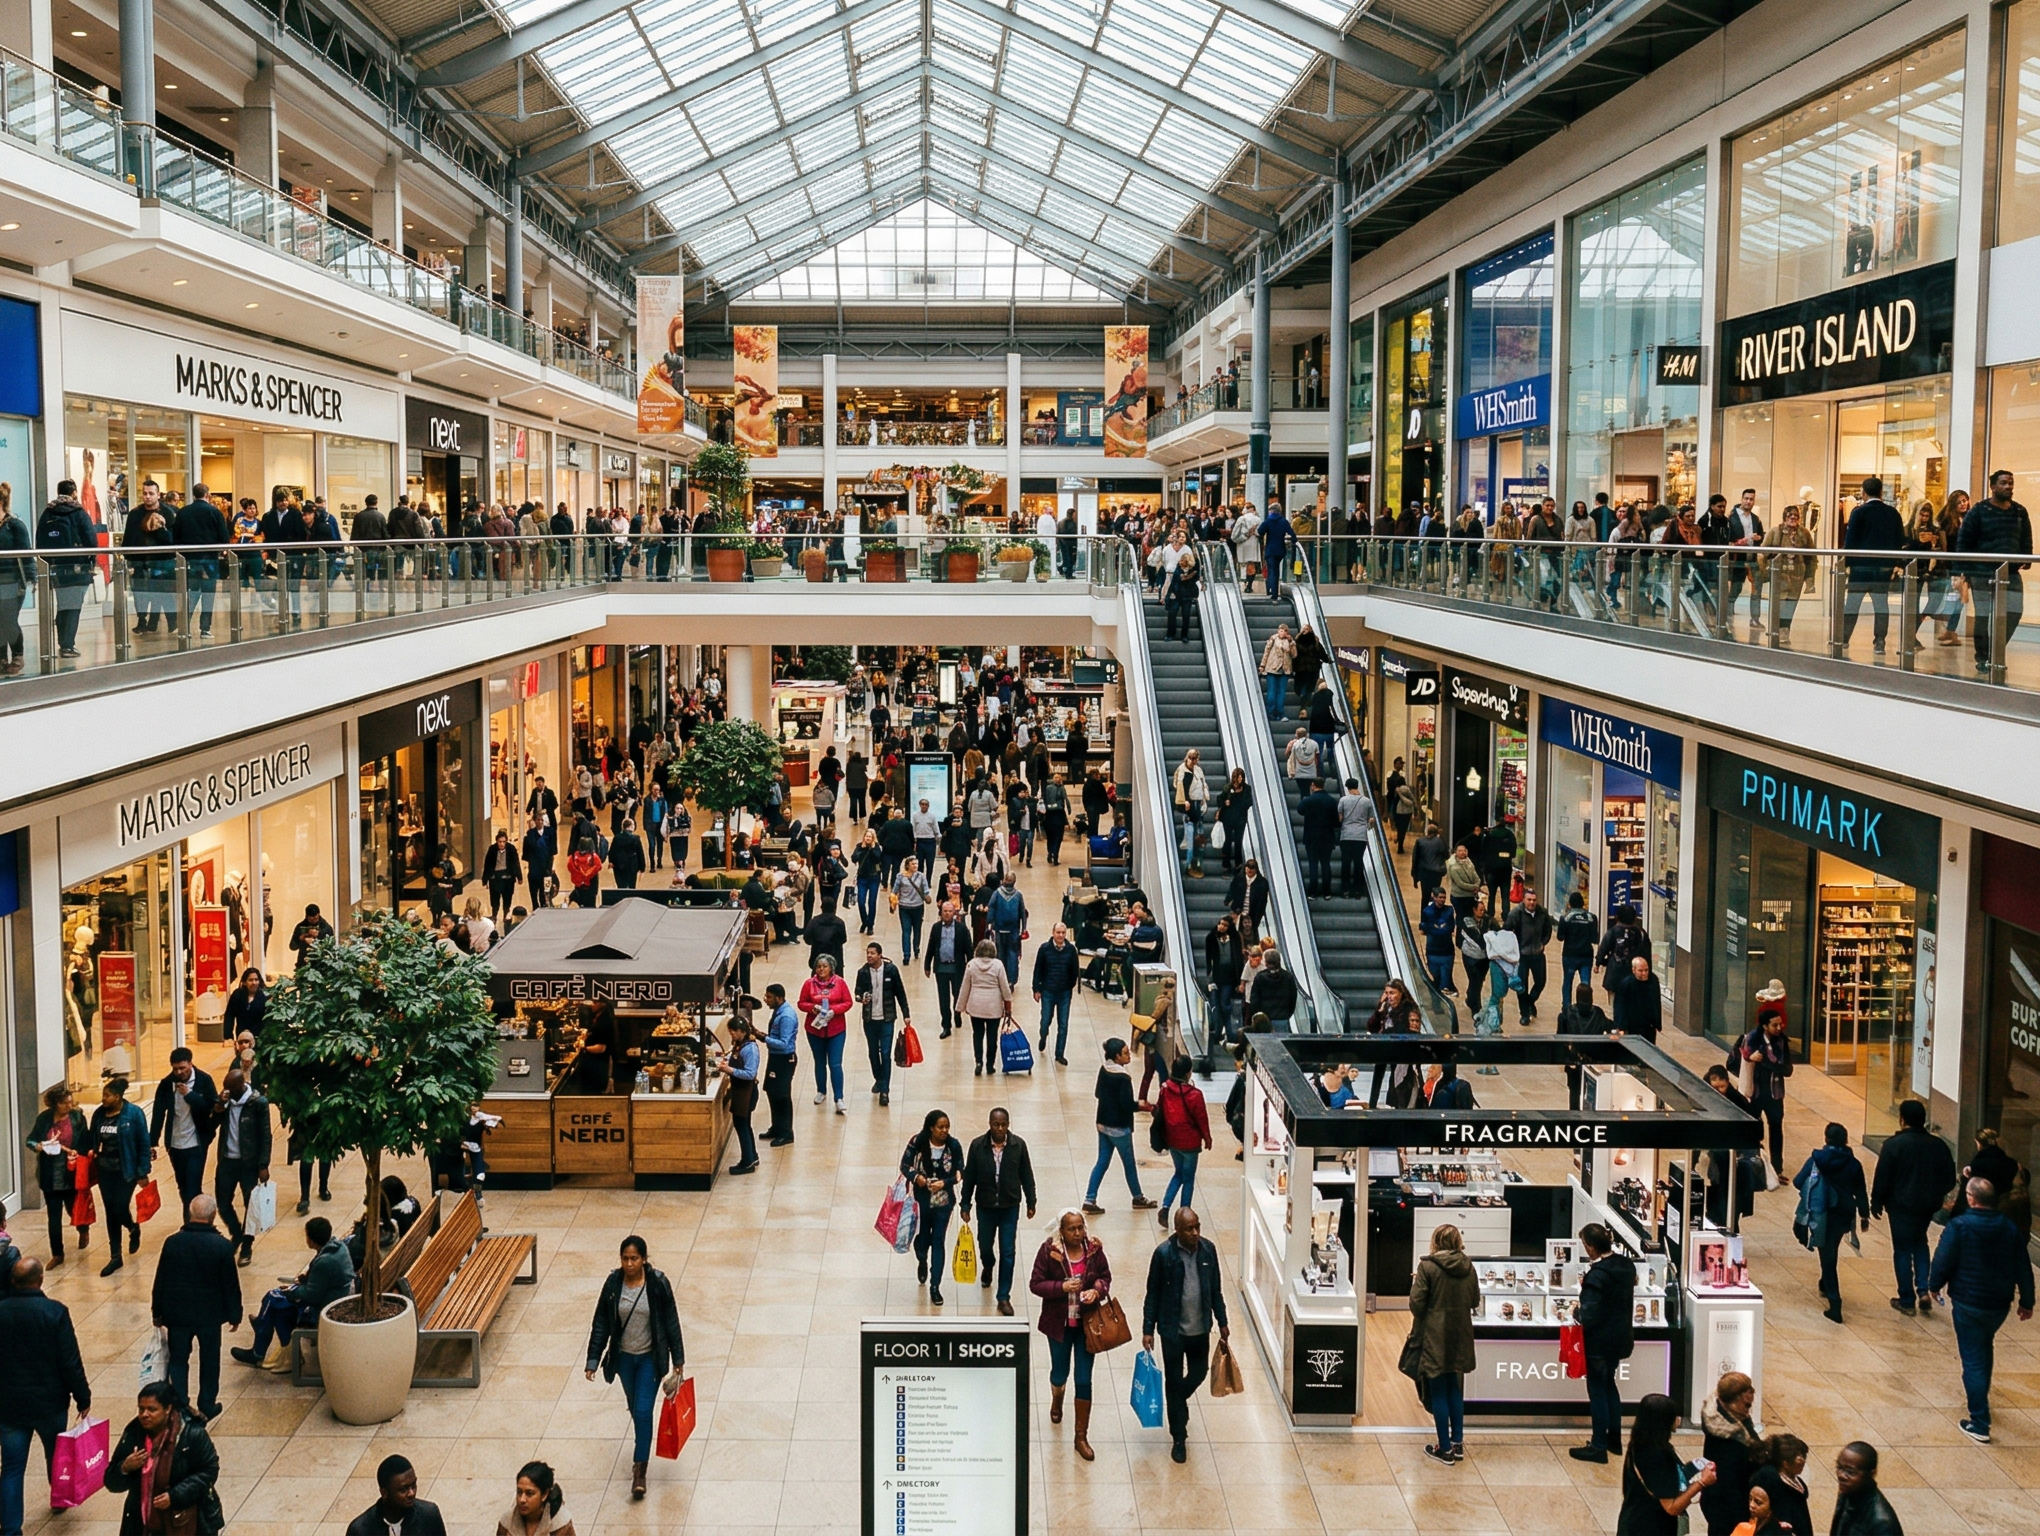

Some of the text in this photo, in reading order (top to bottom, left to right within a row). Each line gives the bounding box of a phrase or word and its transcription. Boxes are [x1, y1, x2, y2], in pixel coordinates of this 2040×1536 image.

[1740, 298, 1916, 382] RIVER ISLAND
[176, 354, 343, 423] MARKS & SPENCER
[1473, 383, 1537, 431] WHSmith
[429, 416, 461, 451] next
[1411, 678, 1436, 696] JD
[416, 694, 452, 737] next
[1570, 709, 1652, 774] WHSmith
[118, 743, 312, 847] MARKS & SPENCER
[1742, 768, 1883, 858] PRIMARK
[592, 979, 673, 1001] NERO
[2010, 1000, 2040, 1030] BUR
[570, 1112, 612, 1125] CAFÉ
[1445, 1124, 1607, 1143] FRAGRANCE
[559, 1128, 625, 1143] NERO
[874, 1343, 1015, 1358] FLOOR 1 SHOPS
[1496, 1362, 1630, 1380] FRAGE
